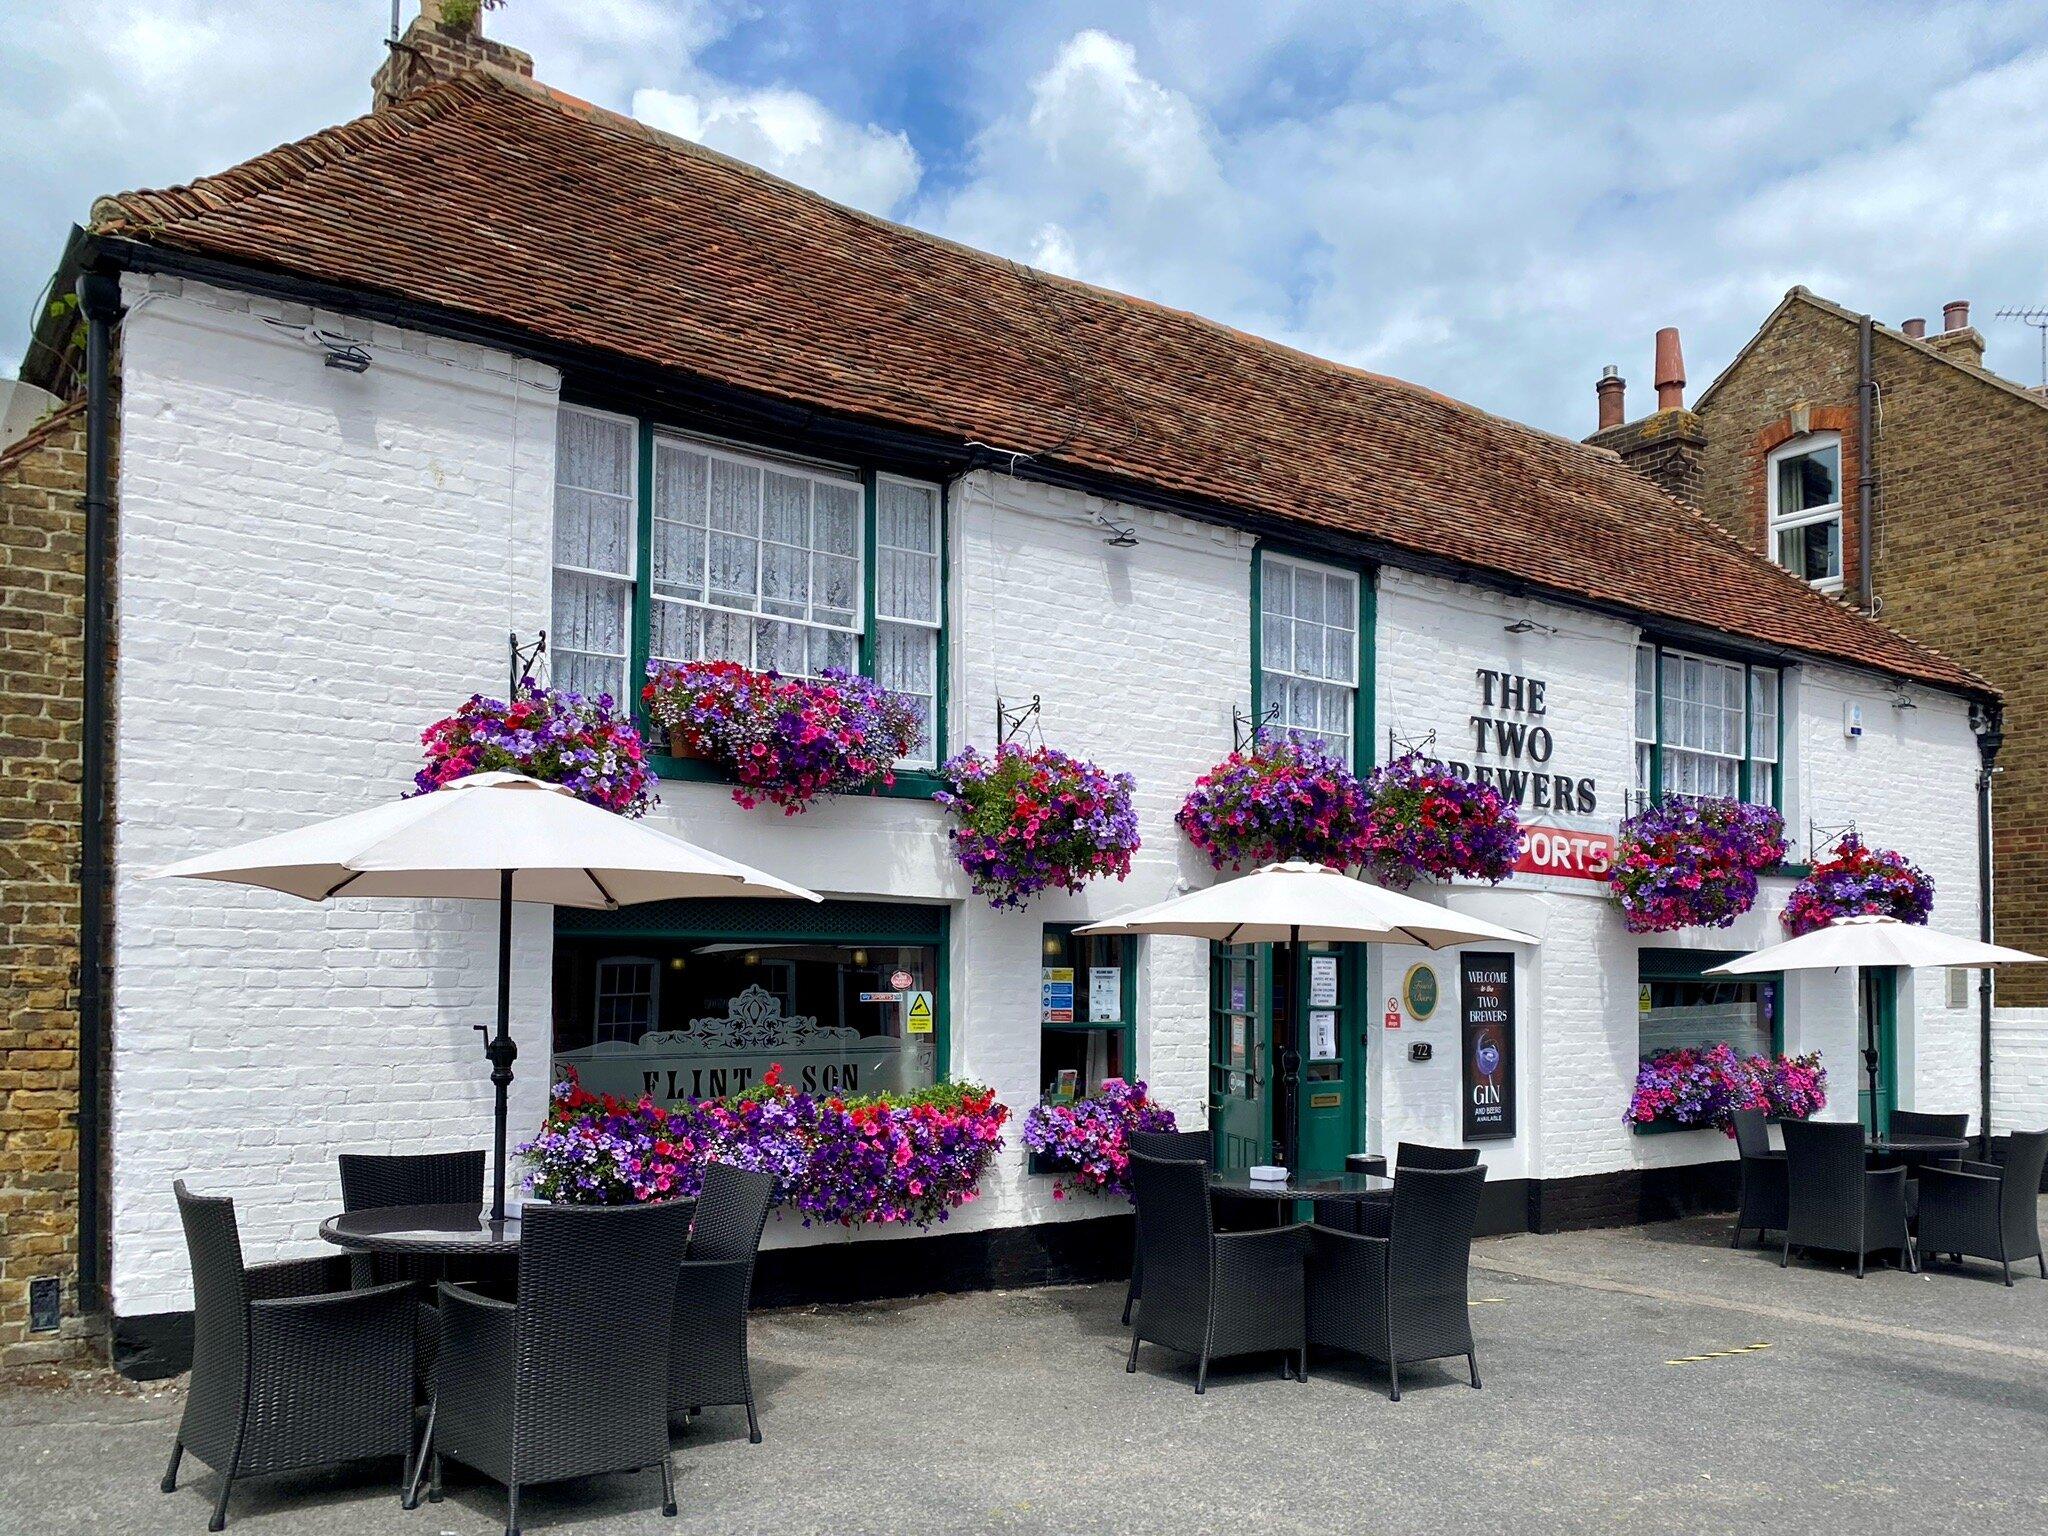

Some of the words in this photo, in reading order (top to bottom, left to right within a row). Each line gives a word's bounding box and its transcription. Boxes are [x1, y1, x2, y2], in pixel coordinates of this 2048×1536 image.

[1476, 668, 1547, 716] THE
[1470, 716, 1553, 762] TWO
[1424, 757, 1597, 813] REWERS
[1511, 832, 1608, 873] PORTS
[1468, 970, 1508, 984] WELCOME
[1477, 996, 1498, 1008] TWO
[1469, 1010, 1508, 1023] BREWERS
[1417, 1044, 1428, 1056] 72
[643, 1068, 752, 1100] FLINT
[1473, 1084, 1500, 1105] GIN
[1475, 1107, 1485, 1115] AND
[1486, 1106, 1502, 1114] BEERS
